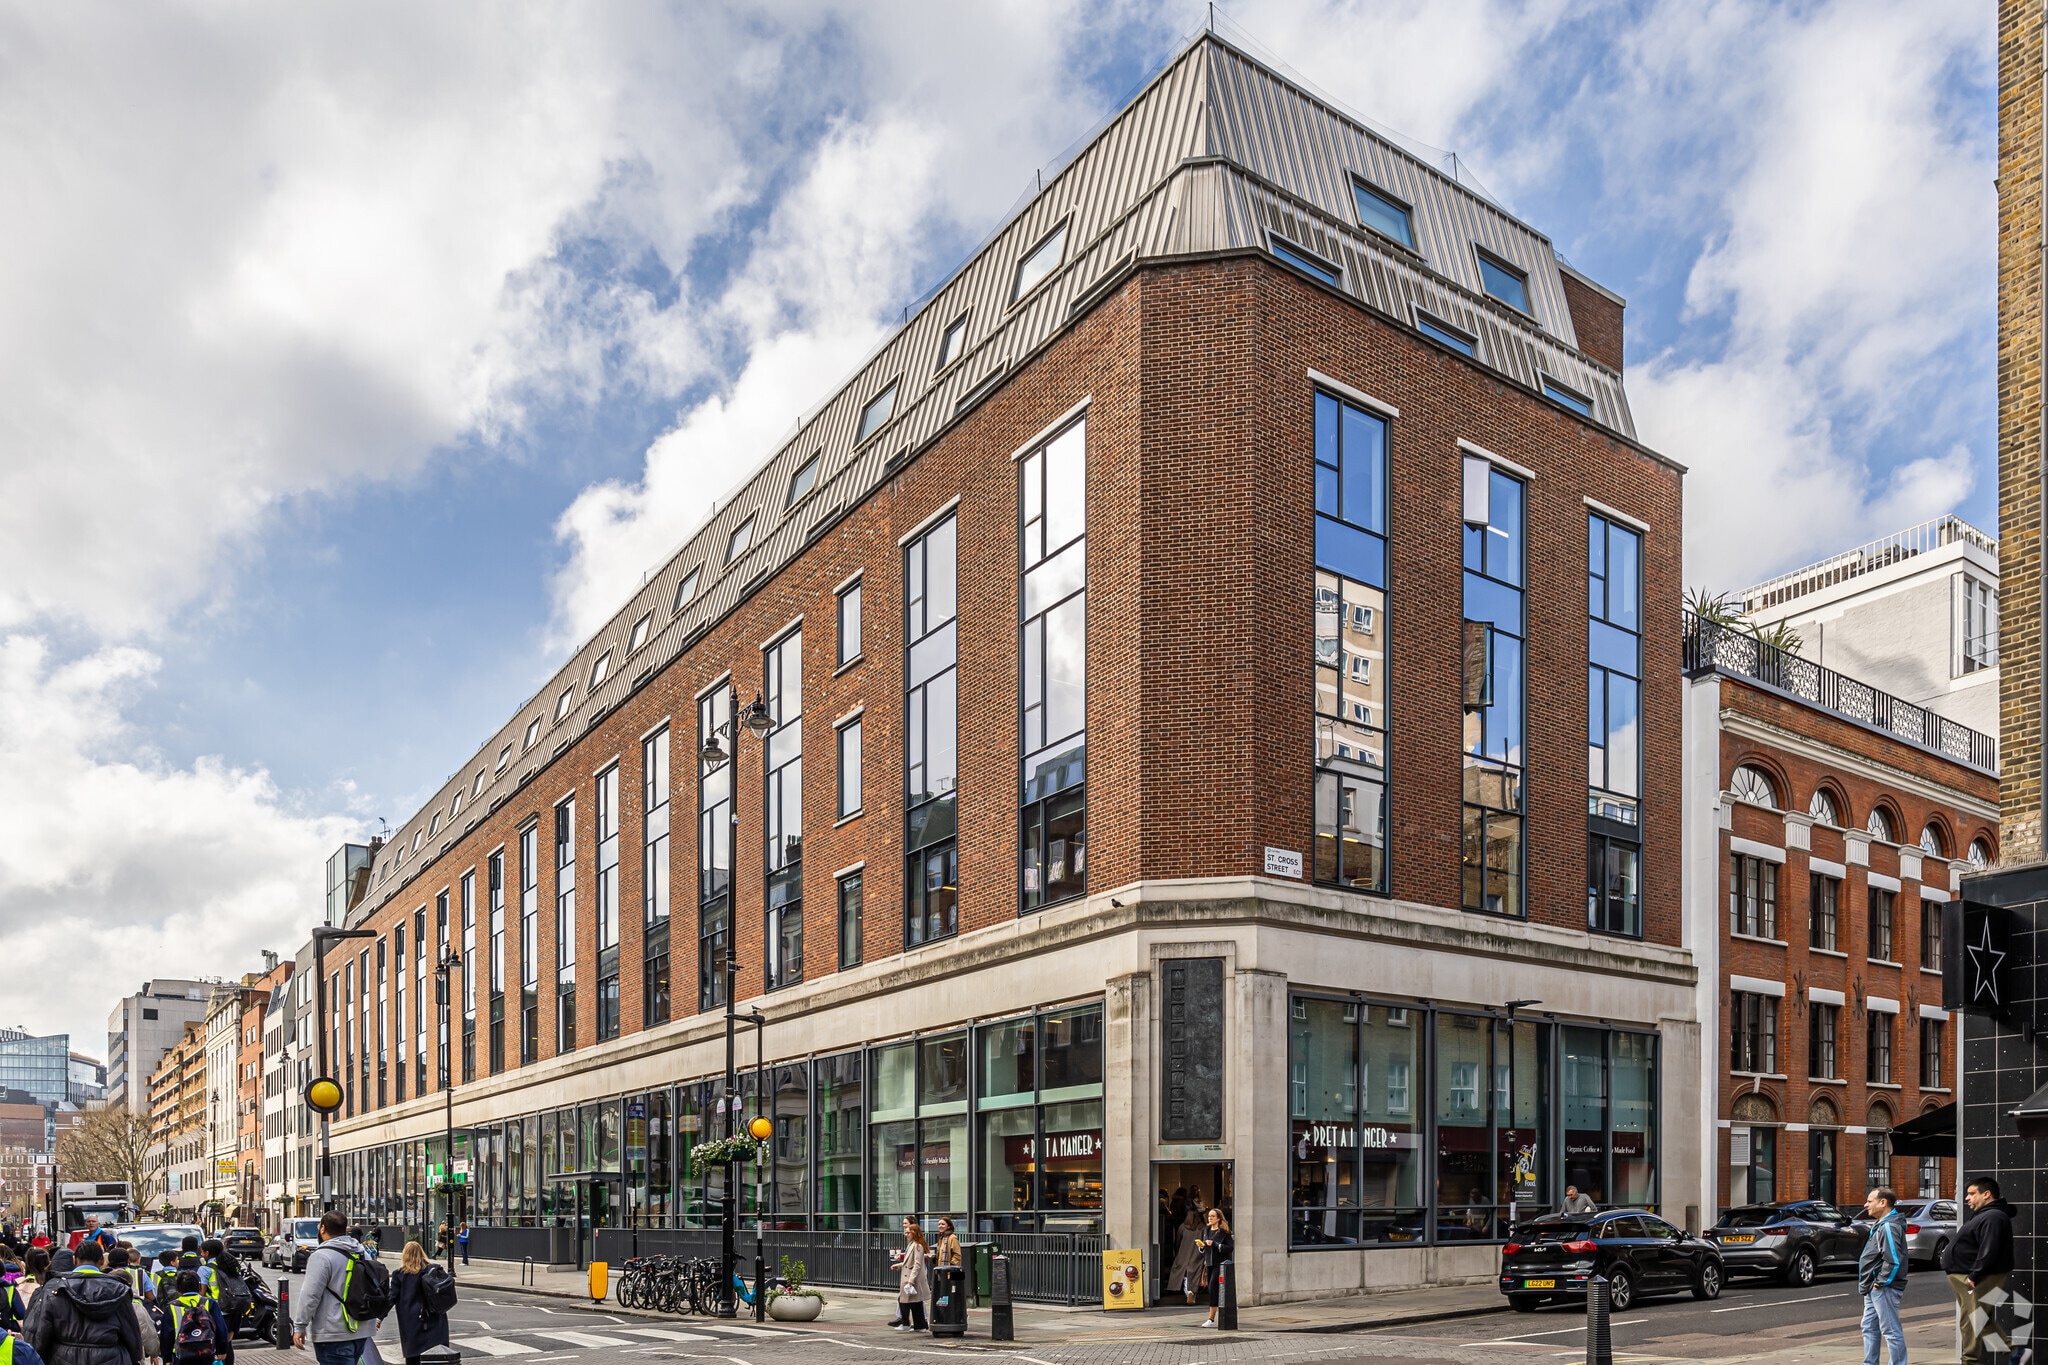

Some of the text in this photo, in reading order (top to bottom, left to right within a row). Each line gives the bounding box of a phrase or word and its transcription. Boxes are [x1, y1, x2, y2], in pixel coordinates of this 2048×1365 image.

[1267, 863, 1288, 873] STREET
[1278, 856, 1299, 866] CROSS
[1313, 1125, 1387, 1148] PRET A NGER
[1030, 1134, 1093, 1158] PT A MANGER
